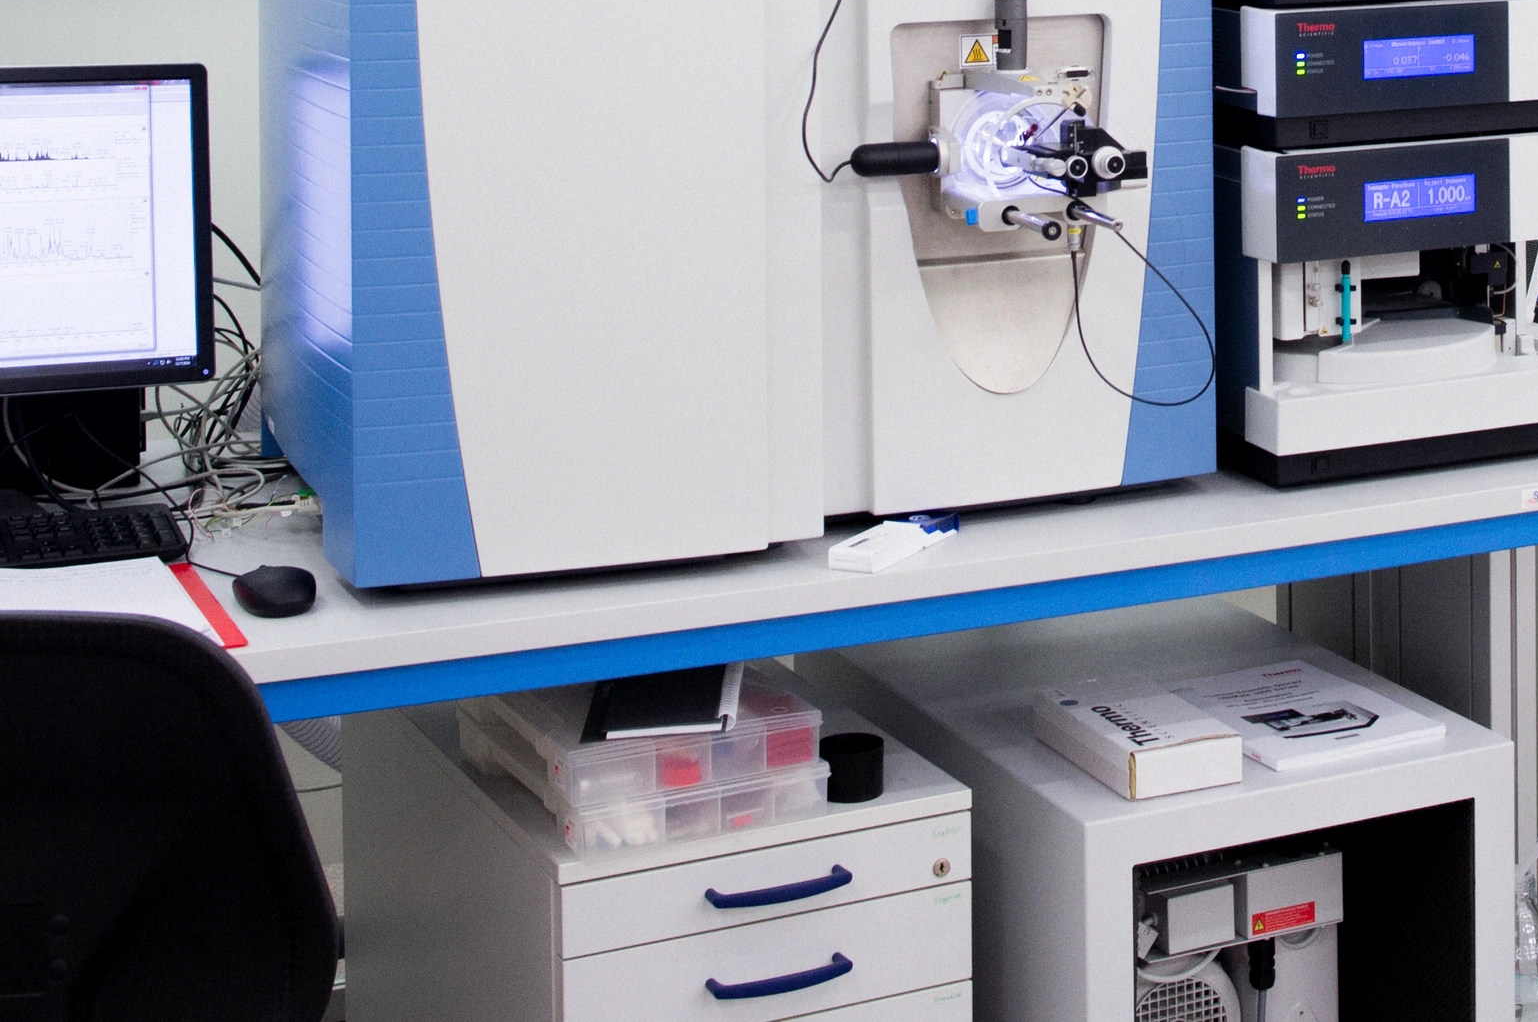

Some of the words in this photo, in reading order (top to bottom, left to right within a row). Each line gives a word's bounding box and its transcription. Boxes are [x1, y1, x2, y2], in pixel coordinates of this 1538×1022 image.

[1297, 22, 1335, 32] Thermo
[1297, 165, 1336, 175] Thermo
[1373, 189, 1411, 210] R-A2
[1427, 185, 1465, 205] 1.000
[1262, 669, 1302, 677] Thermo
[1091, 705, 1160, 746] Thermo
